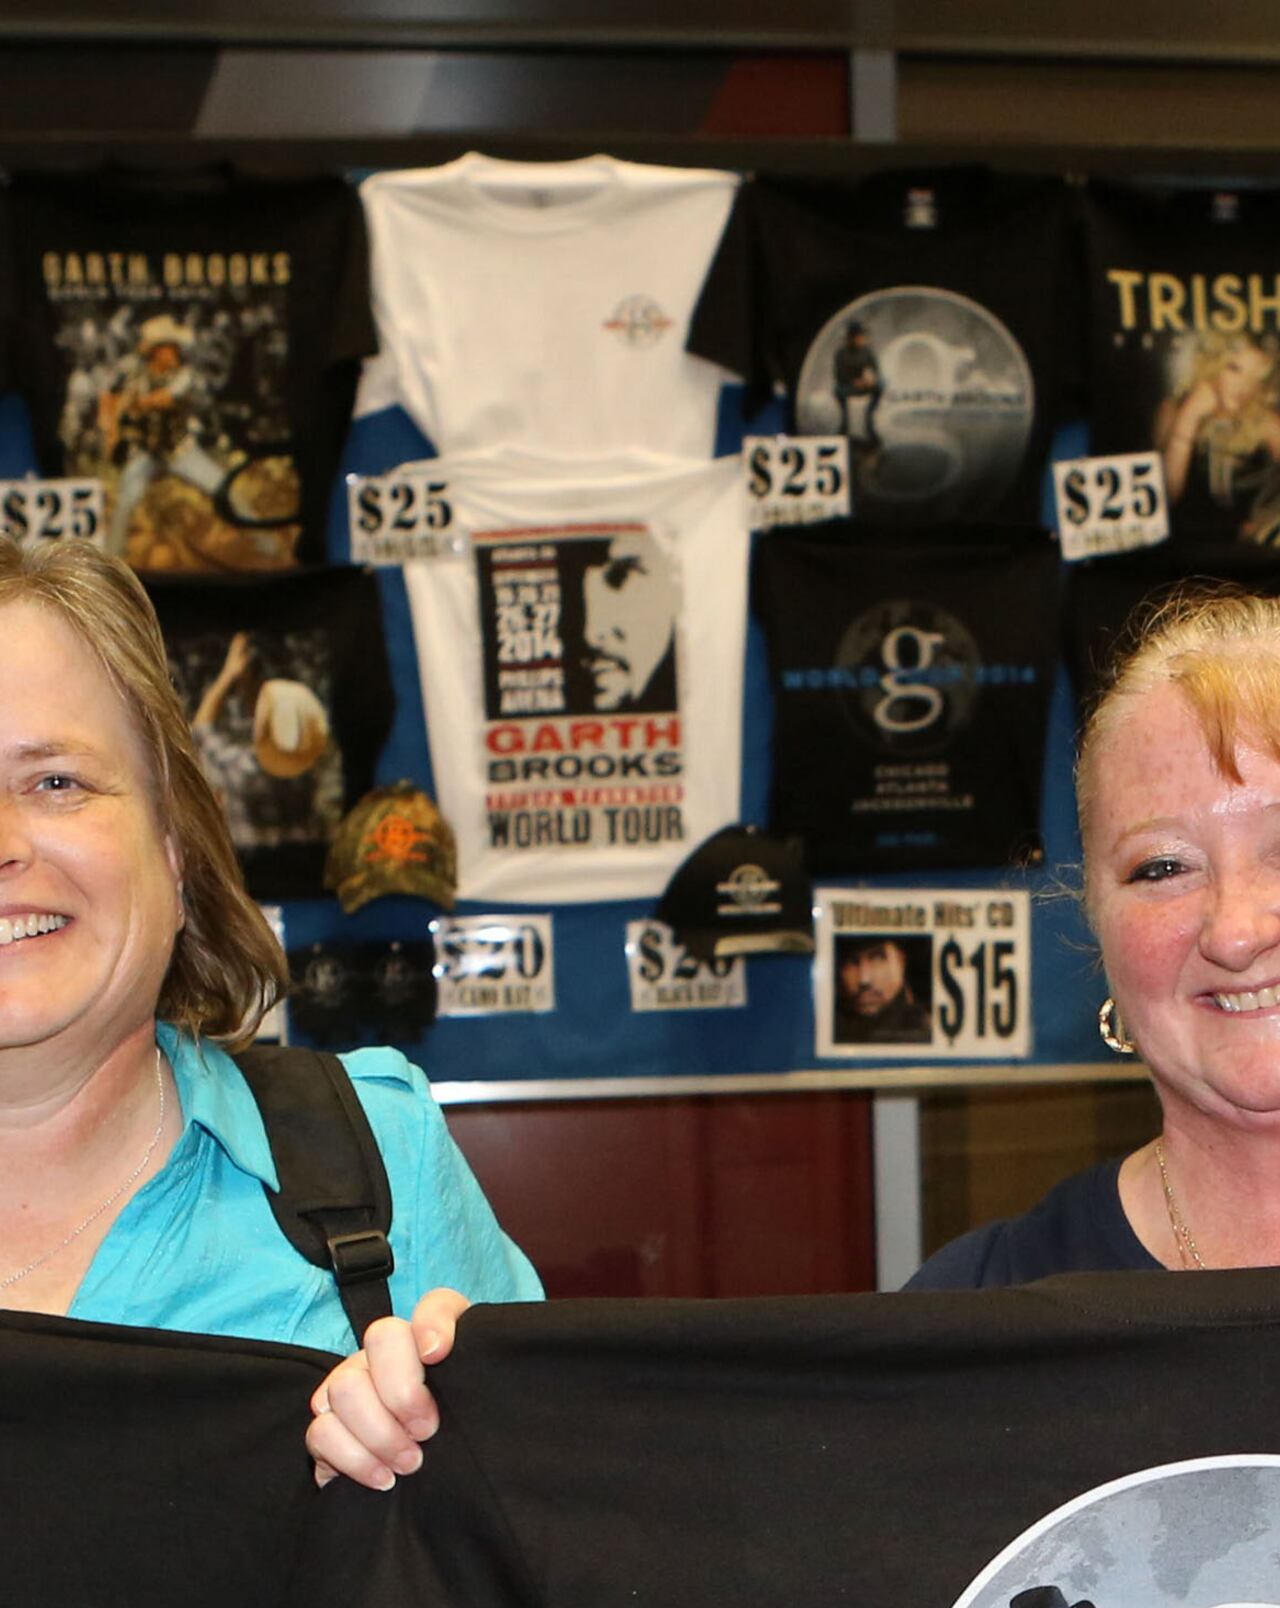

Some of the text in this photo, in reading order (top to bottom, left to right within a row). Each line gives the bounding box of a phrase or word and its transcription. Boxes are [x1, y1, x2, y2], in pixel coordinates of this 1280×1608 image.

[163, 251, 291, 284] BROOKS
[749, 446, 841, 498] $25
[2, 488, 97, 542] $25
[358, 482, 452, 533] $25
[1063, 463, 1158, 527] $25
[498, 630, 563, 663] 2014
[486, 719, 681, 756] GARTH
[488, 752, 684, 784] BROOKS
[488, 805, 686, 848] WORLD TOUR
[987, 902, 1015, 928] CD
[939, 934, 1018, 1046] $15
